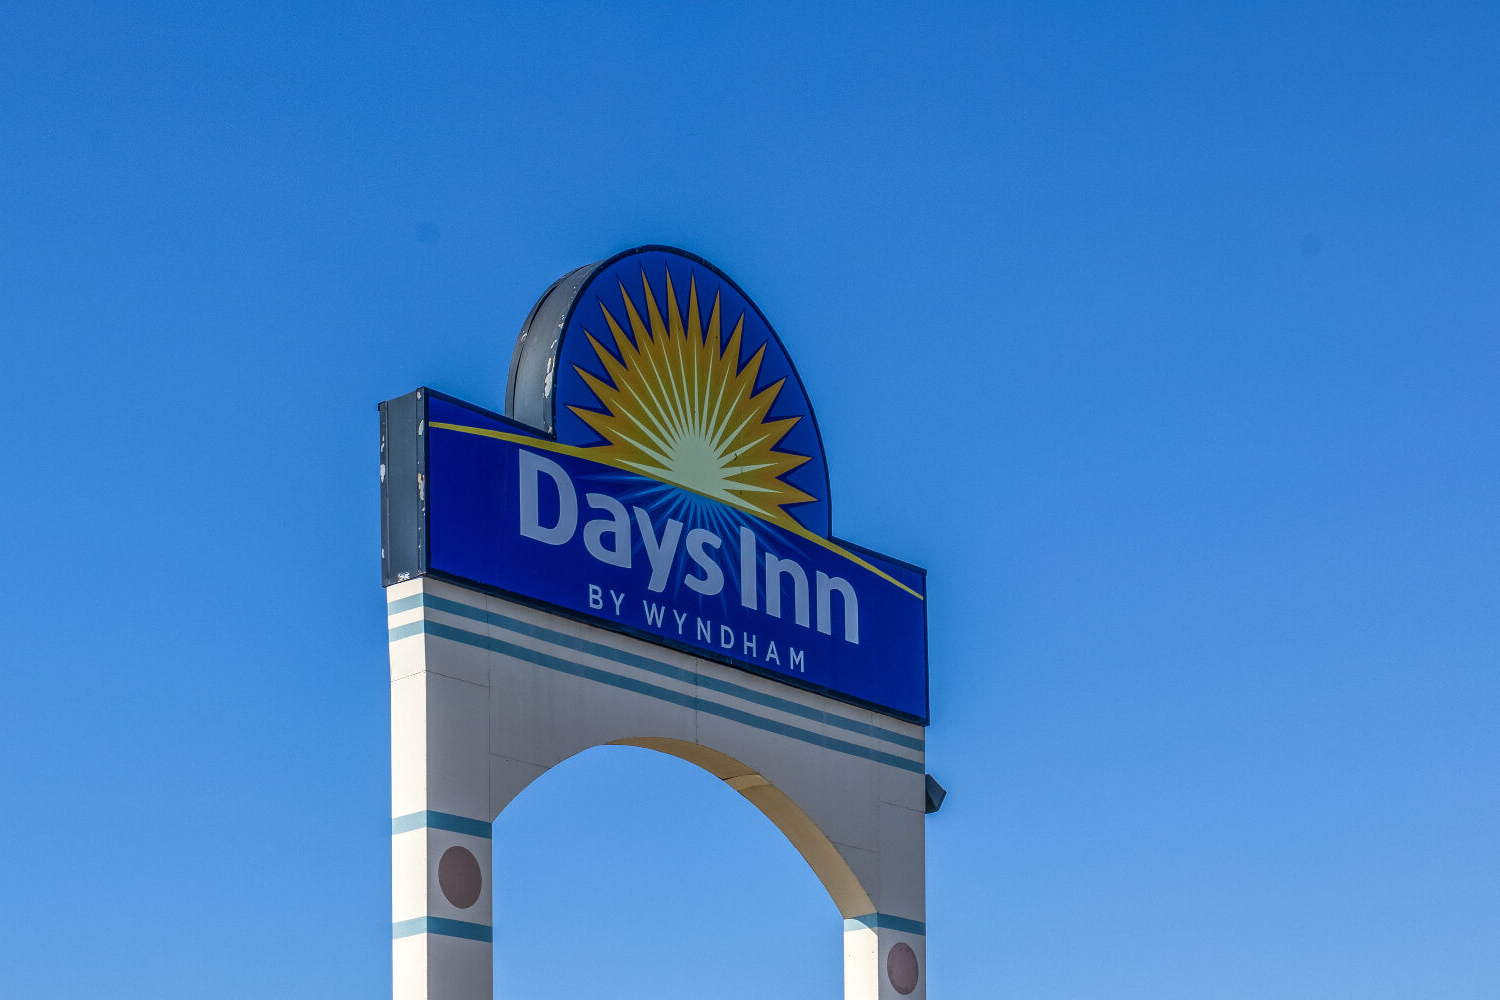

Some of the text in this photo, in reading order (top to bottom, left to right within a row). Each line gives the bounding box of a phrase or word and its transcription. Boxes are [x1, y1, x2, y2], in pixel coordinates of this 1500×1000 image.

[518, 448, 860, 645] Days Inn
[588, 583, 805, 673] BY WYNDHAM
